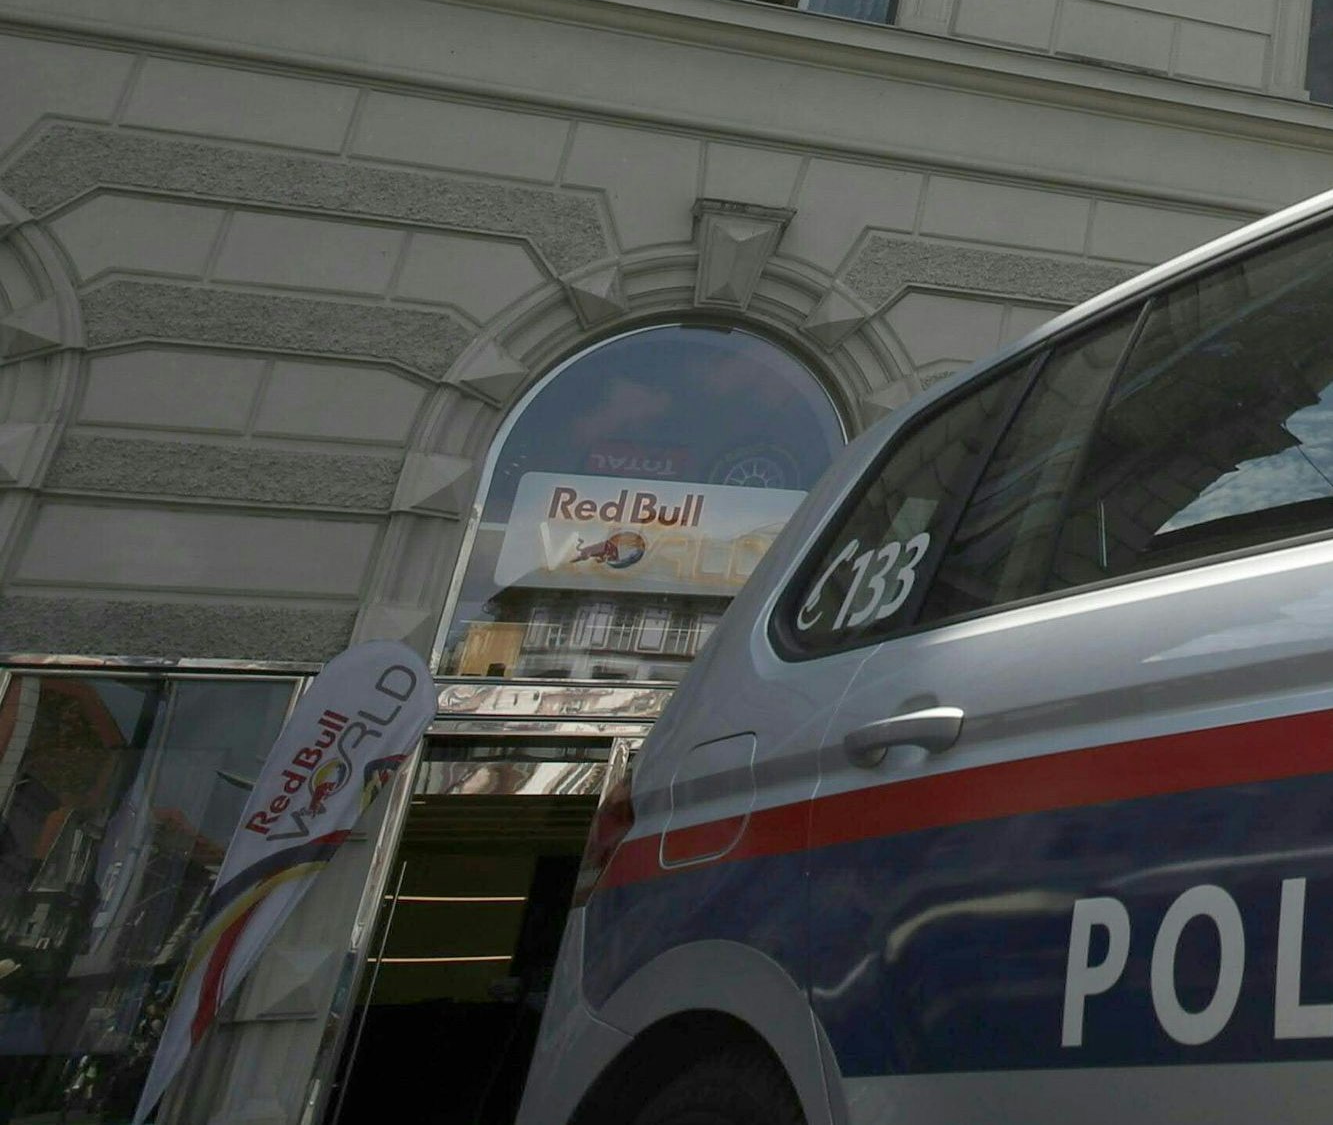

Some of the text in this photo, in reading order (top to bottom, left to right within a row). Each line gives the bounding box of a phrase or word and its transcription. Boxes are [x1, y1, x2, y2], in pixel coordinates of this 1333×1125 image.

[548, 486, 705, 527] Red Bull
[832, 532, 931, 631] 133
[245, 709, 350, 835] Red Bull
